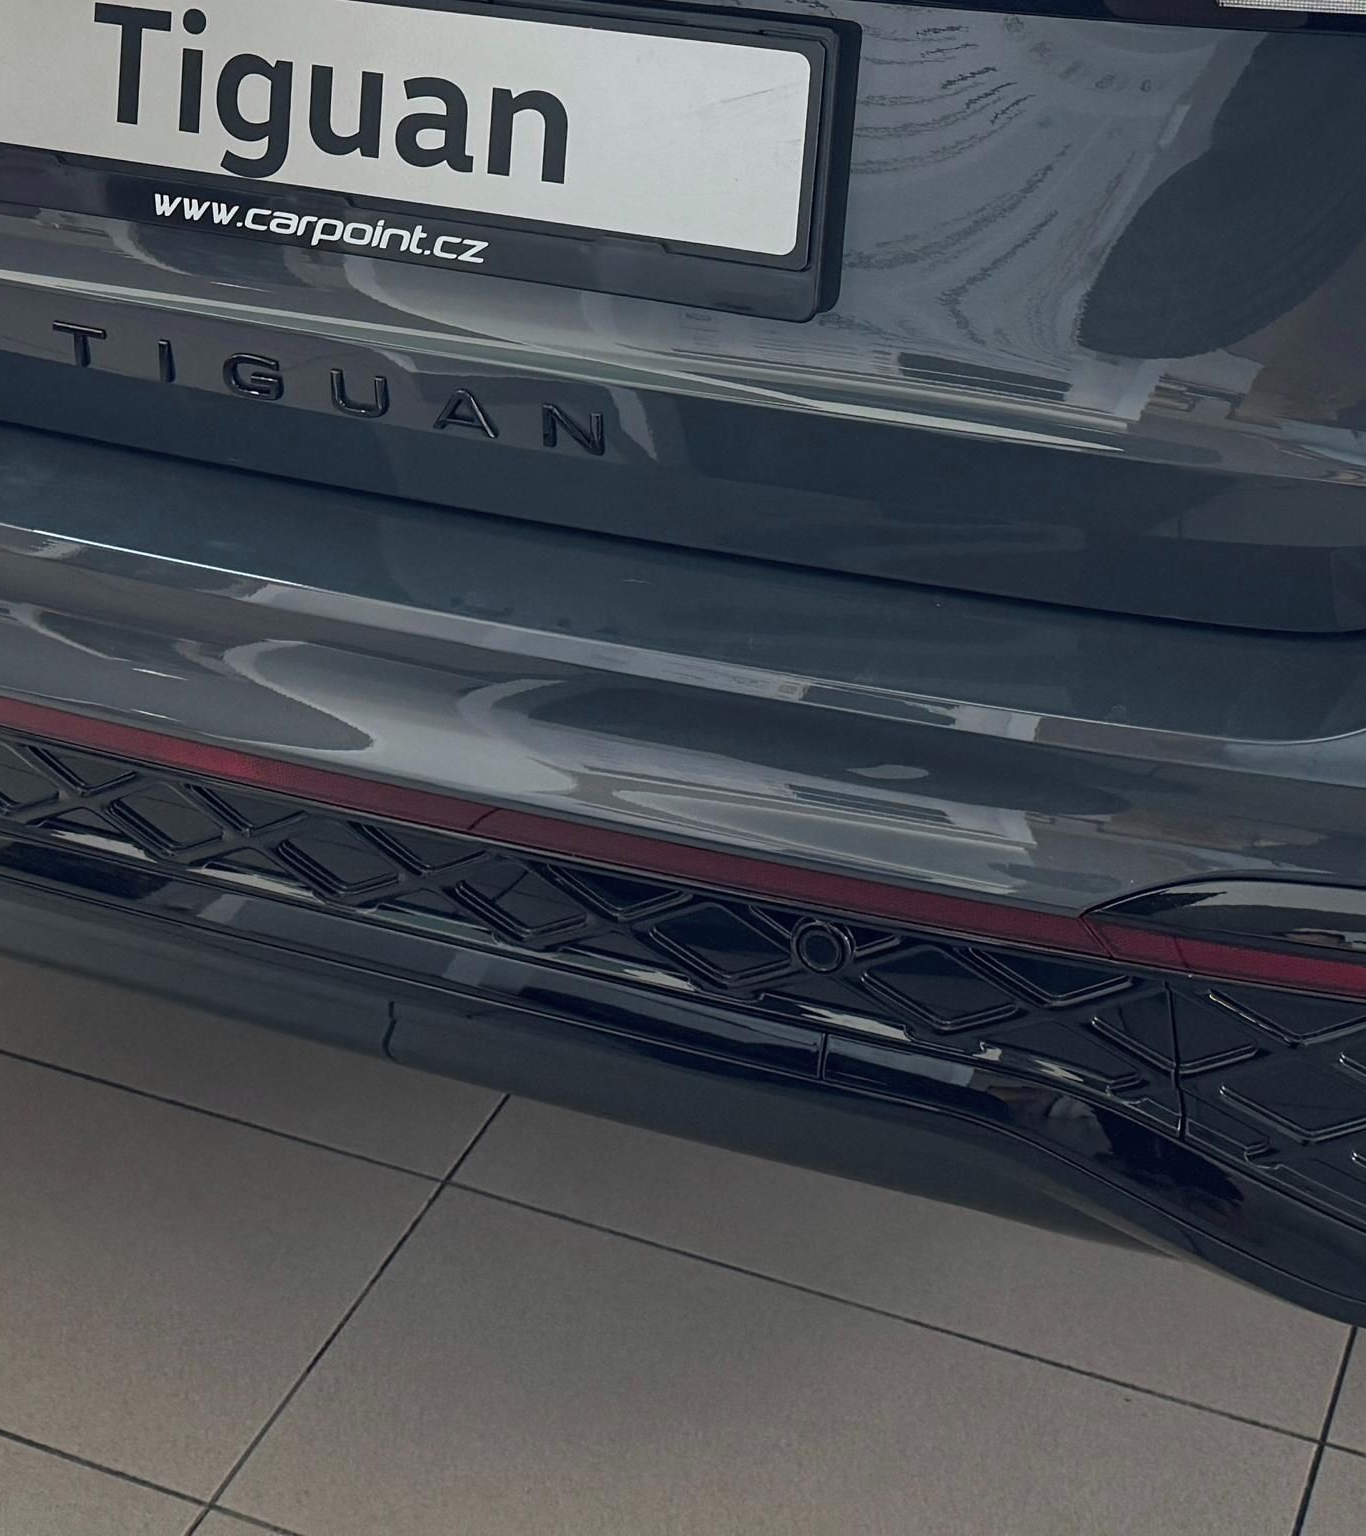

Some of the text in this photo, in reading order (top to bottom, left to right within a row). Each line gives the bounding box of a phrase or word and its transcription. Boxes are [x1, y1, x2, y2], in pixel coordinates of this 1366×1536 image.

[93, 2, 569, 184] Tiguan
[153, 191, 489, 264] www.carpoint.cz
[52, 320, 605, 456] TIGUAN
